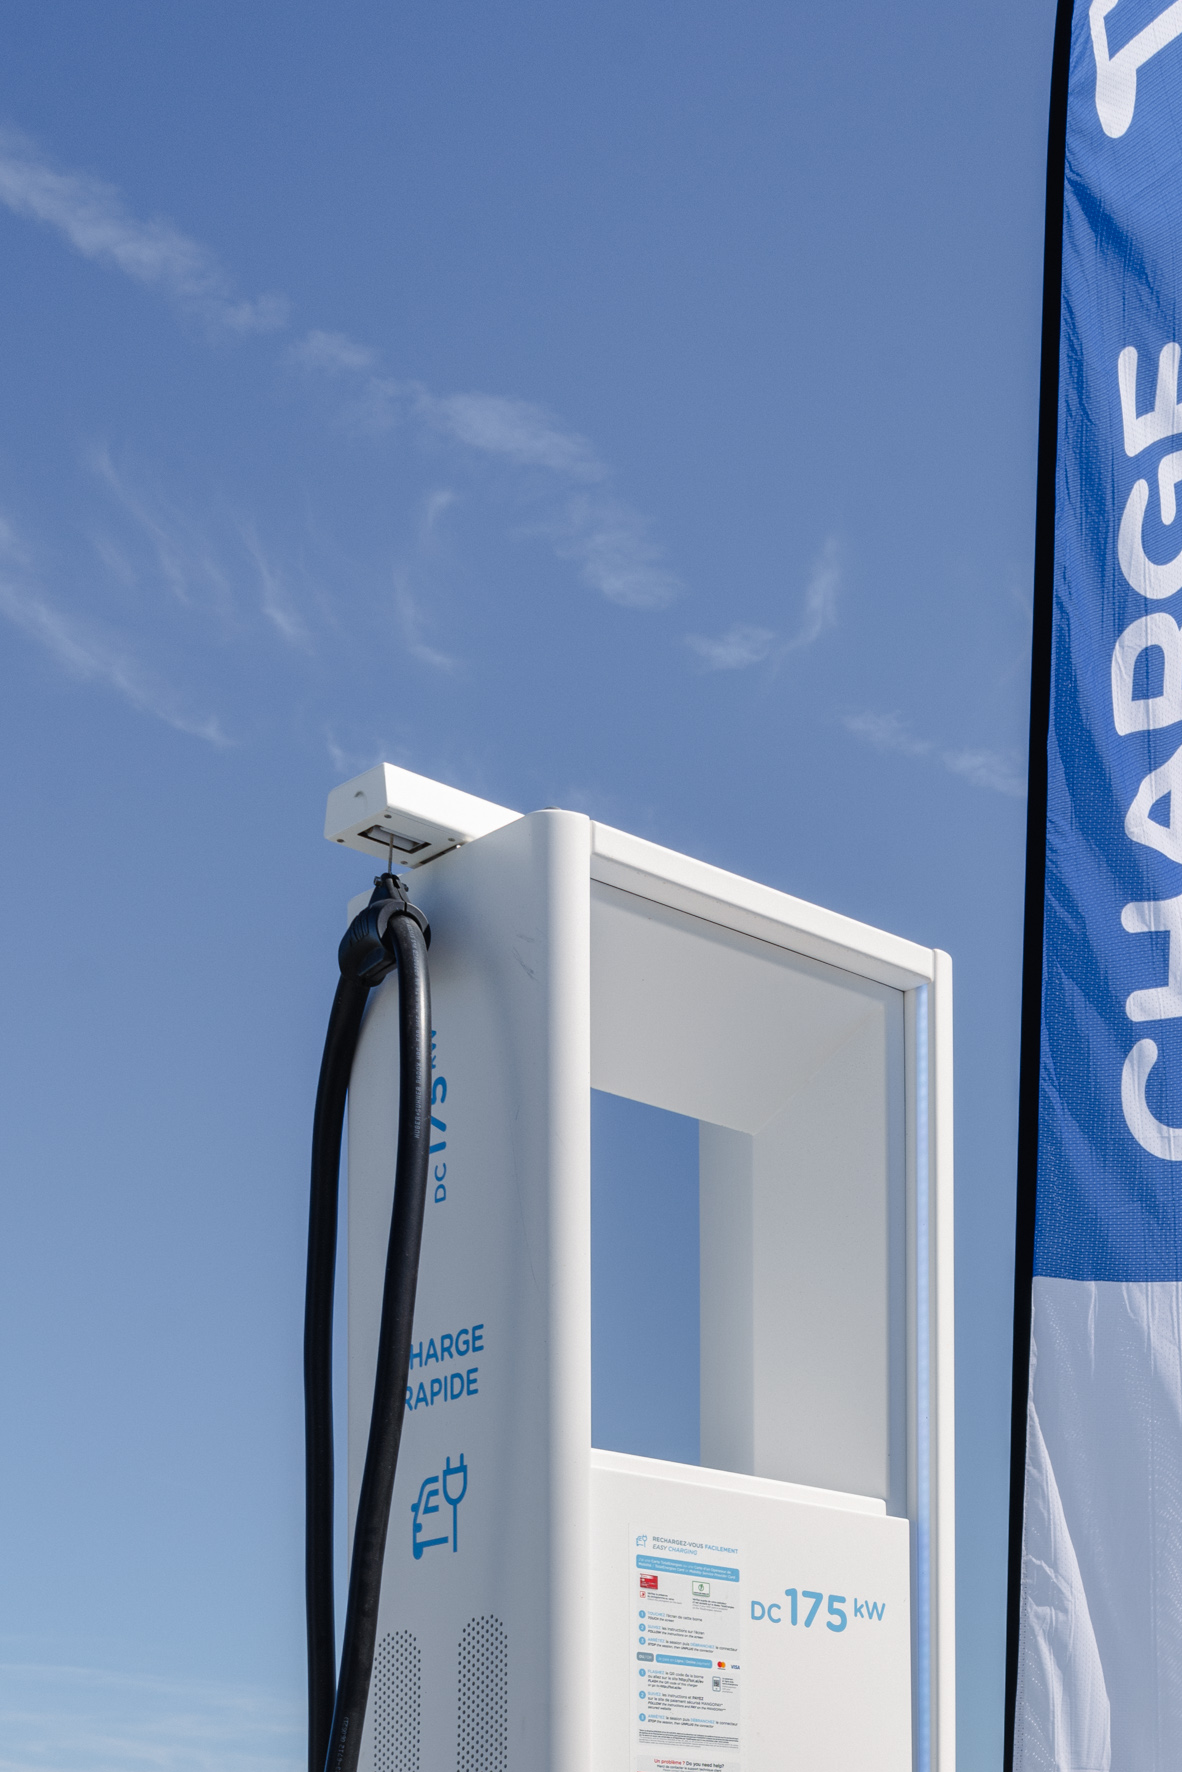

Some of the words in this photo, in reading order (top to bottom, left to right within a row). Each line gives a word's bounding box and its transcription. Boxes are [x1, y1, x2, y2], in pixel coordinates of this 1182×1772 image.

[434, 1162, 447, 1203] DC
[409, 1323, 484, 1370] HARGE
[652, 1536, 703, 1549] RECHARGEZ-VOUS
[704, 1544, 738, 1554] FACILEMENT
[668, 1546, 698, 1555] CHARGING
[750, 1600, 782, 1624] DC
[785, 1588, 848, 1632] 175
[854, 1597, 886, 1622] kW
